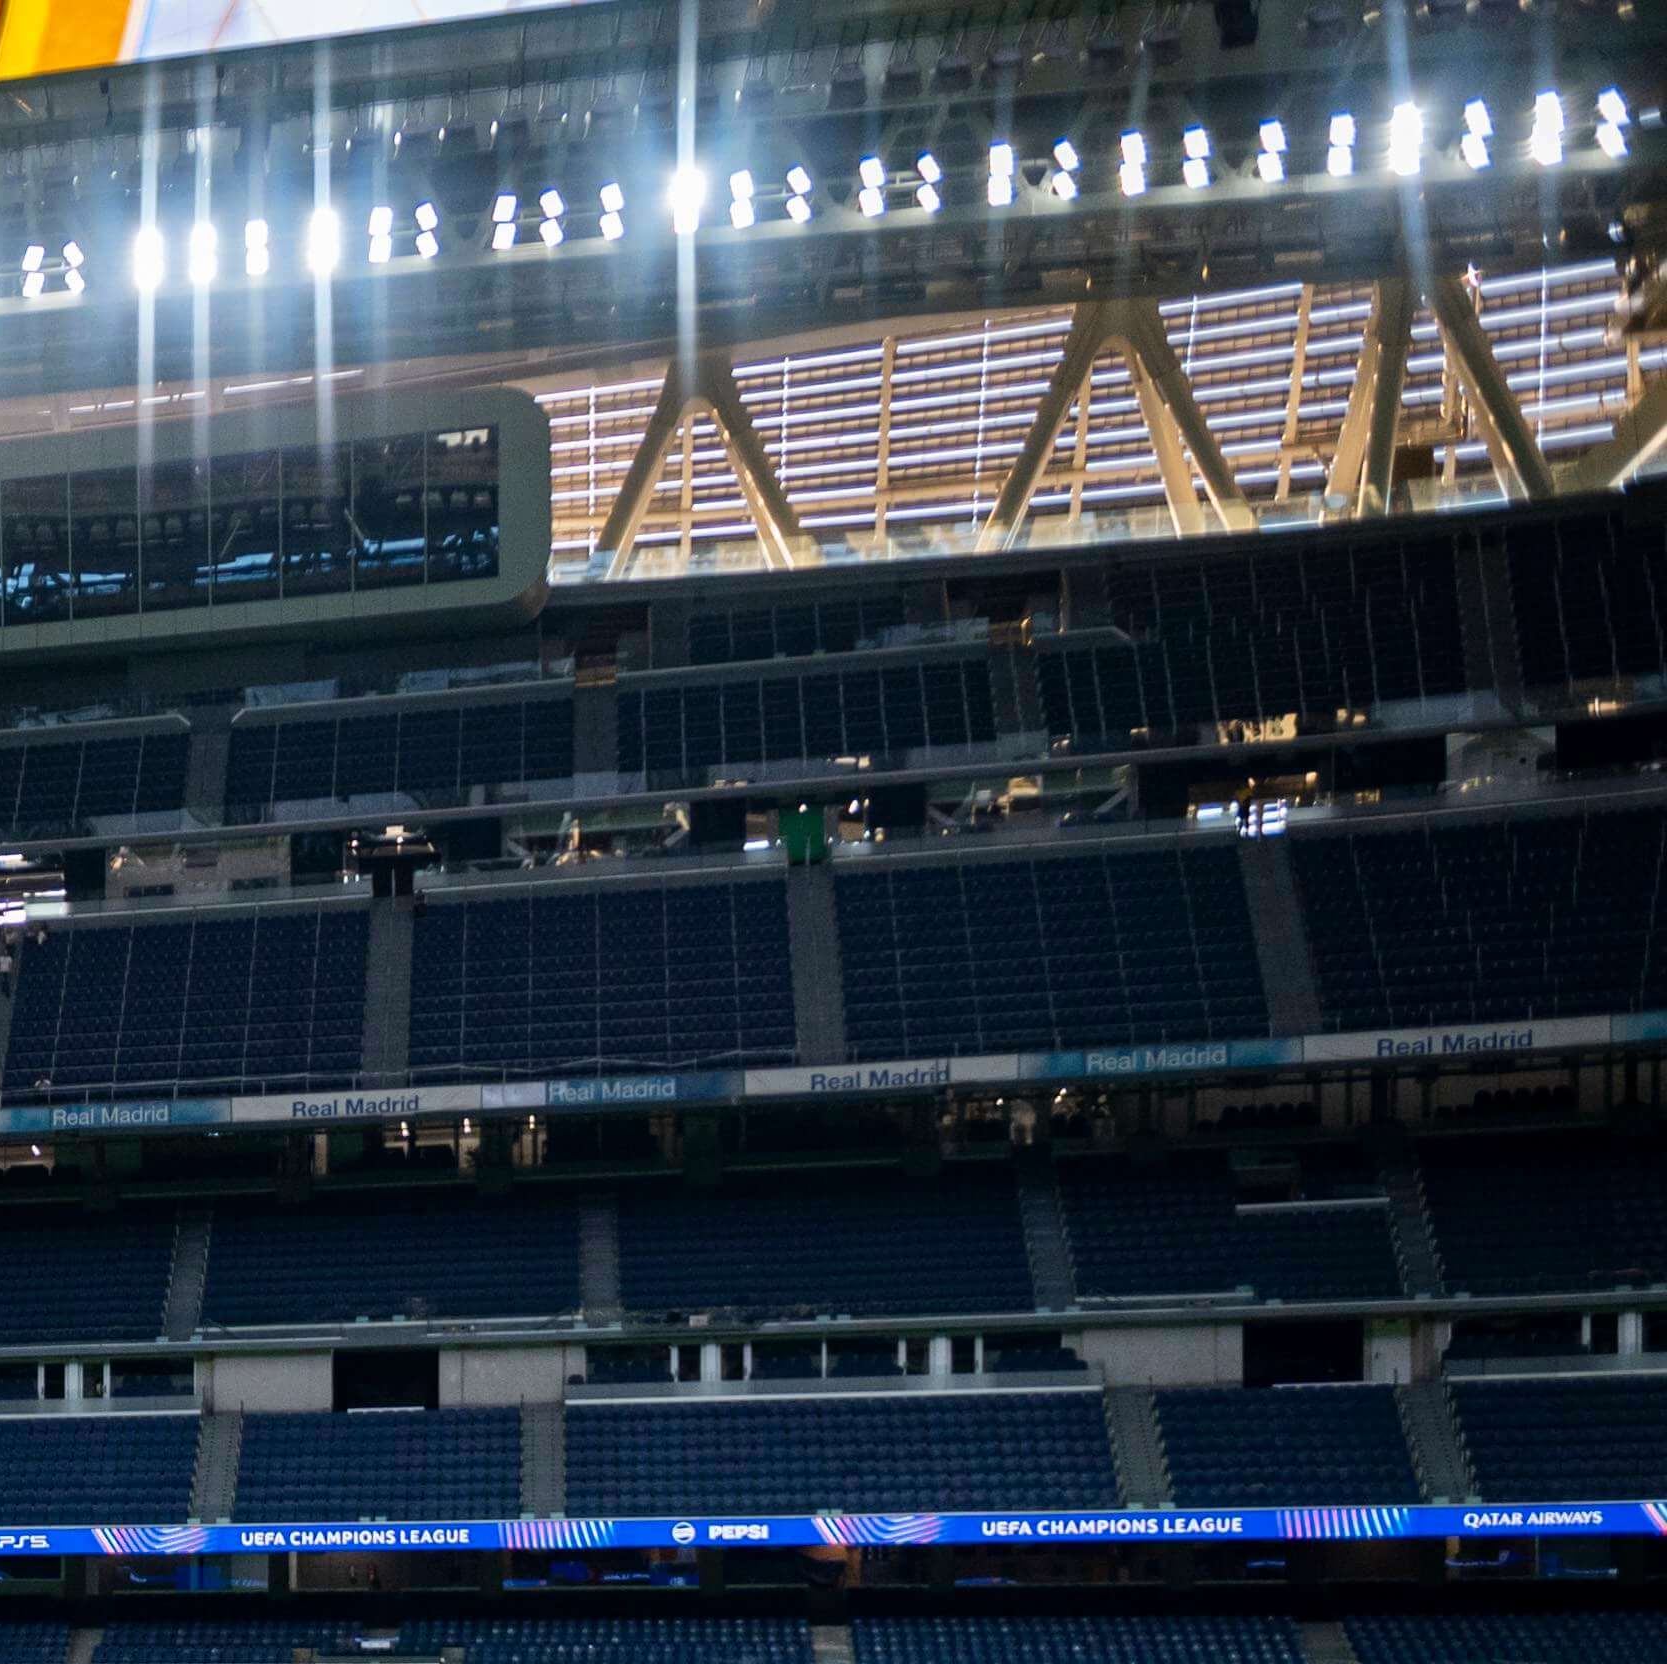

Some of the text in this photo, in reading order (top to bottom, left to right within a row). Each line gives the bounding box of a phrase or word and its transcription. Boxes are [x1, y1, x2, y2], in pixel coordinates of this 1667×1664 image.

[1377, 1029, 1533, 1058] Real Madrid
[1086, 1046, 1227, 1072] Real Madrid
[548, 1077, 676, 1101] Real Madrid
[810, 1066, 949, 1091] Real Madrid
[53, 1104, 168, 1126] Real Madrid
[292, 1095, 419, 1119] Real Madrid
[982, 1517, 1243, 1536] UEFA CHAMPIONS LEAGUE
[1463, 1510, 1603, 1529] QATAR AIRWAYS
[241, 1529, 469, 1546] UEFA CHAMPIONS LEAGUE
[708, 1525, 769, 1540] PEPSI
